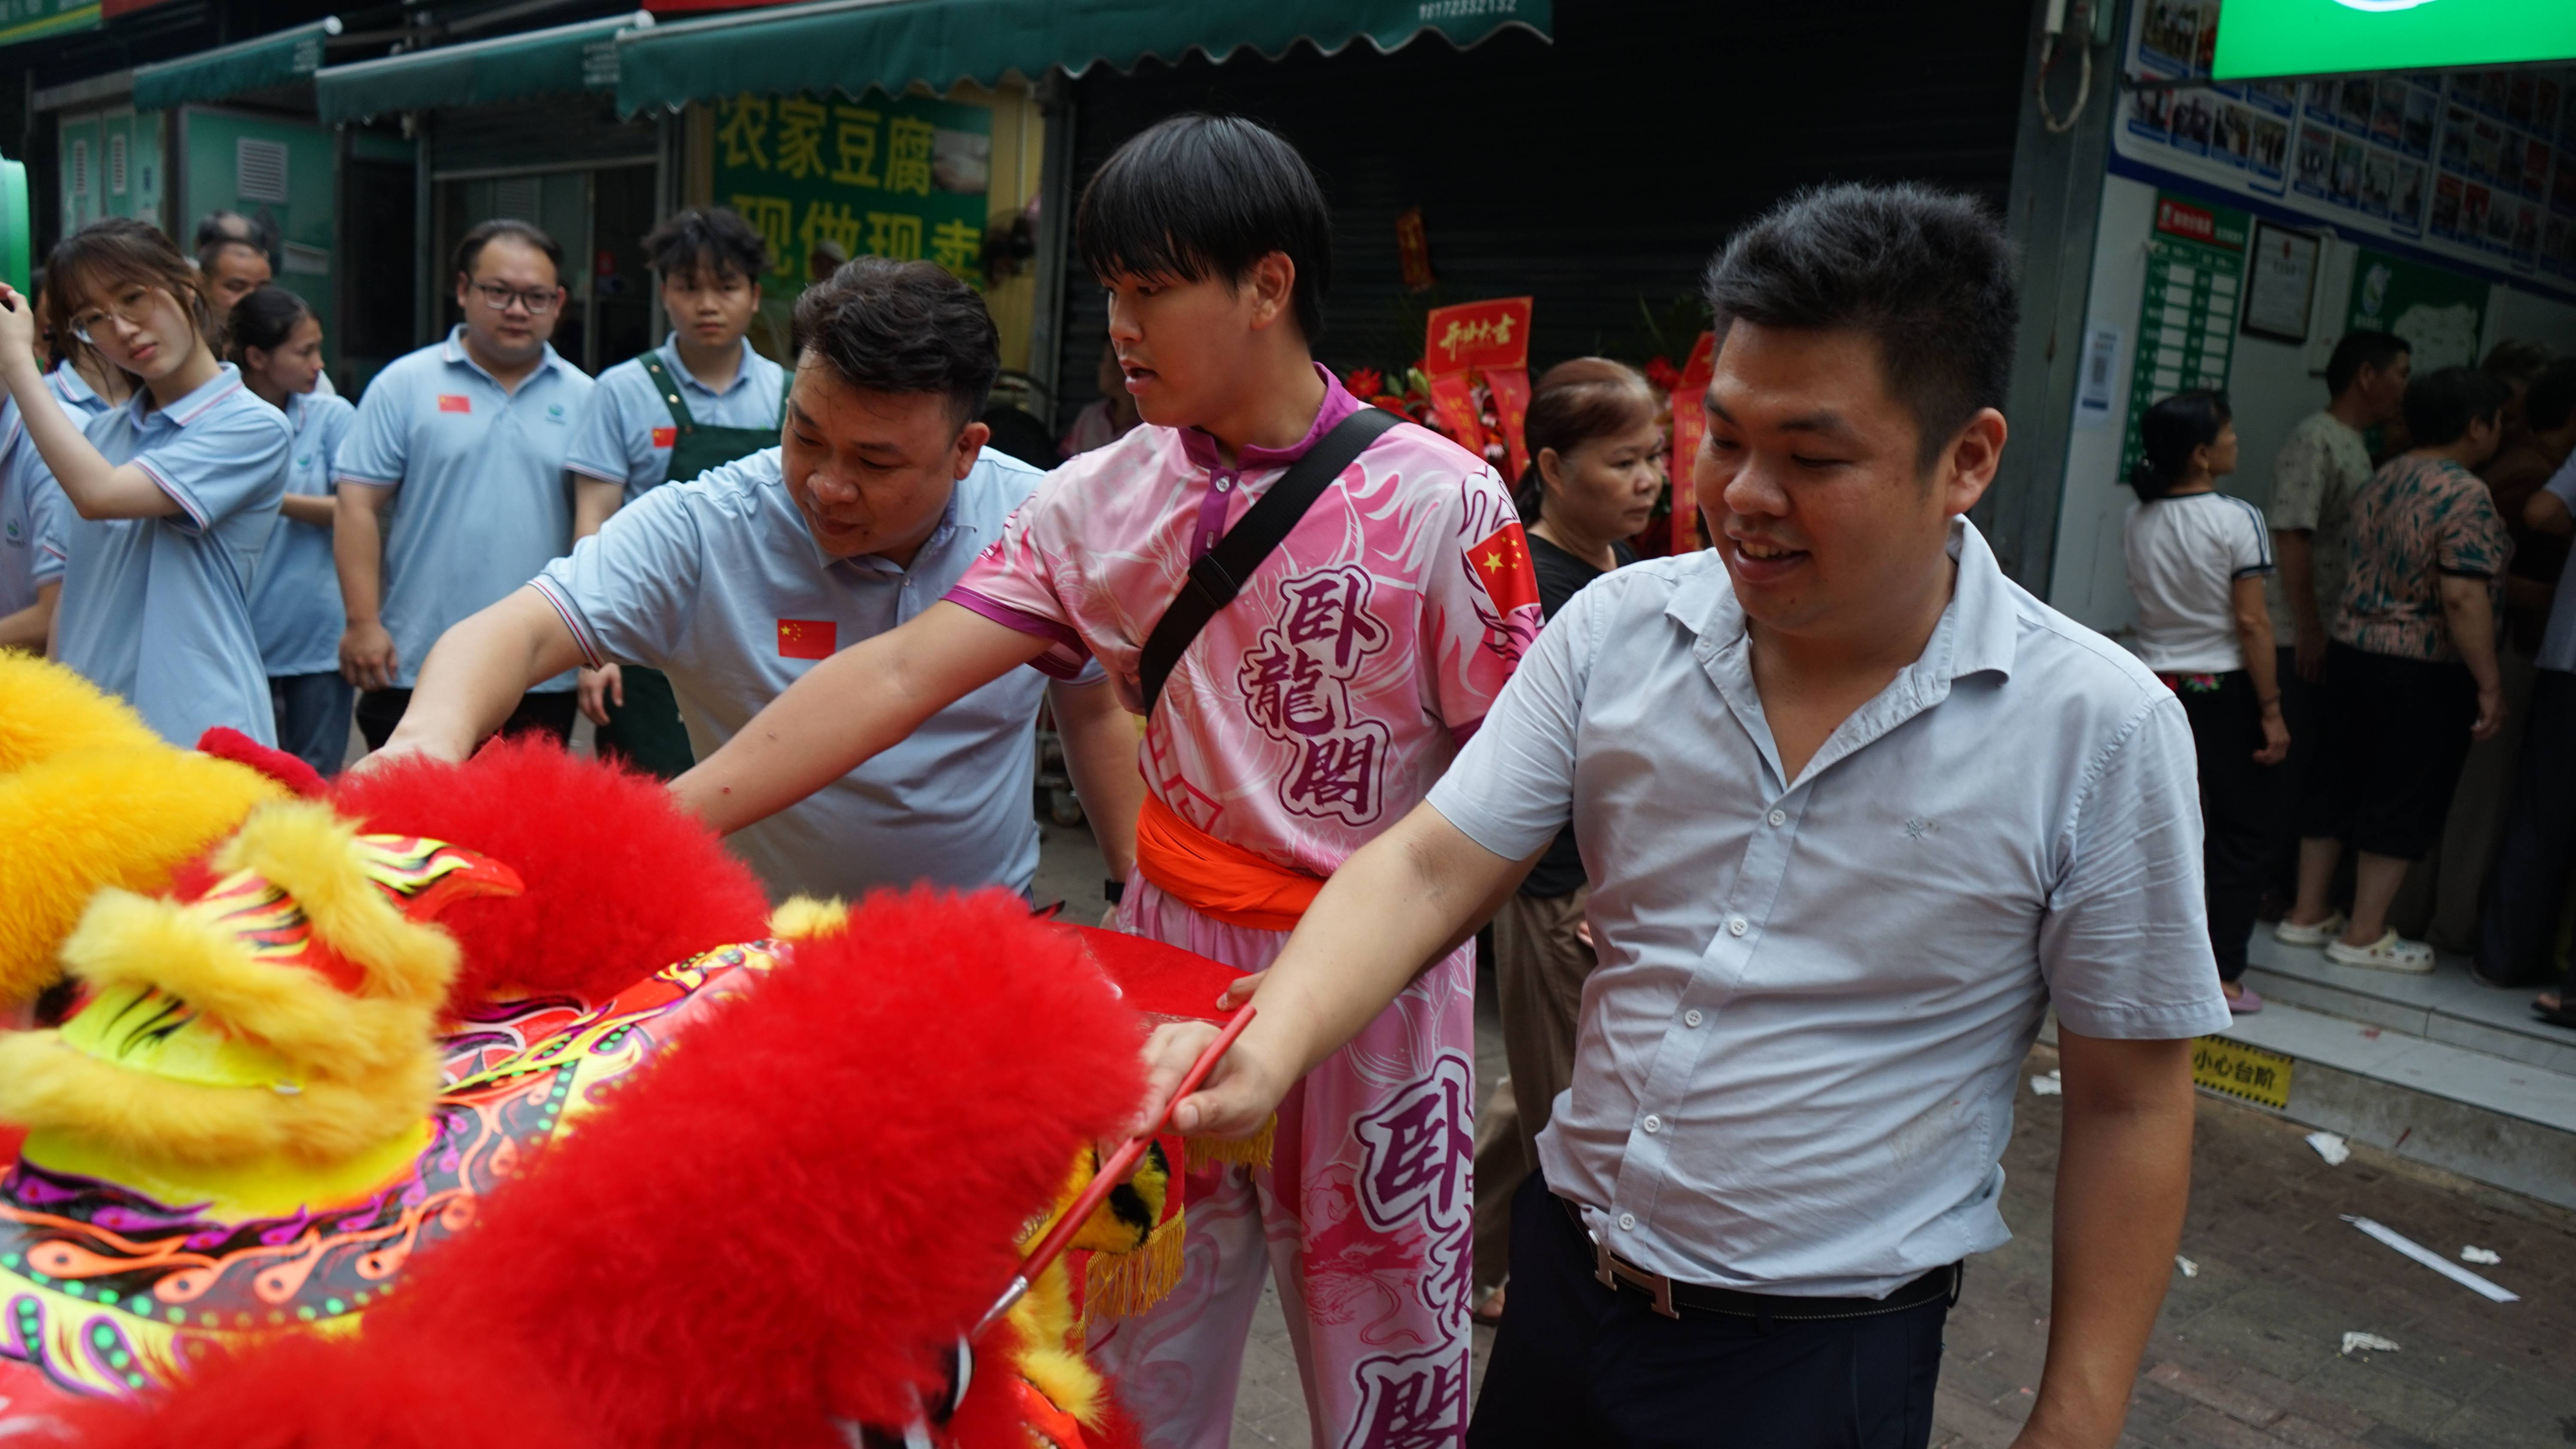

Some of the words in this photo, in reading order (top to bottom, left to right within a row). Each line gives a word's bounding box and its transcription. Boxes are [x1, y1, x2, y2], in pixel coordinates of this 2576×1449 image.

[718, 93, 934, 197] 农家豆腐
[1247, 572, 1377, 815] 卧龍閣
[2193, 1049, 2276, 1090] 小心台阶
